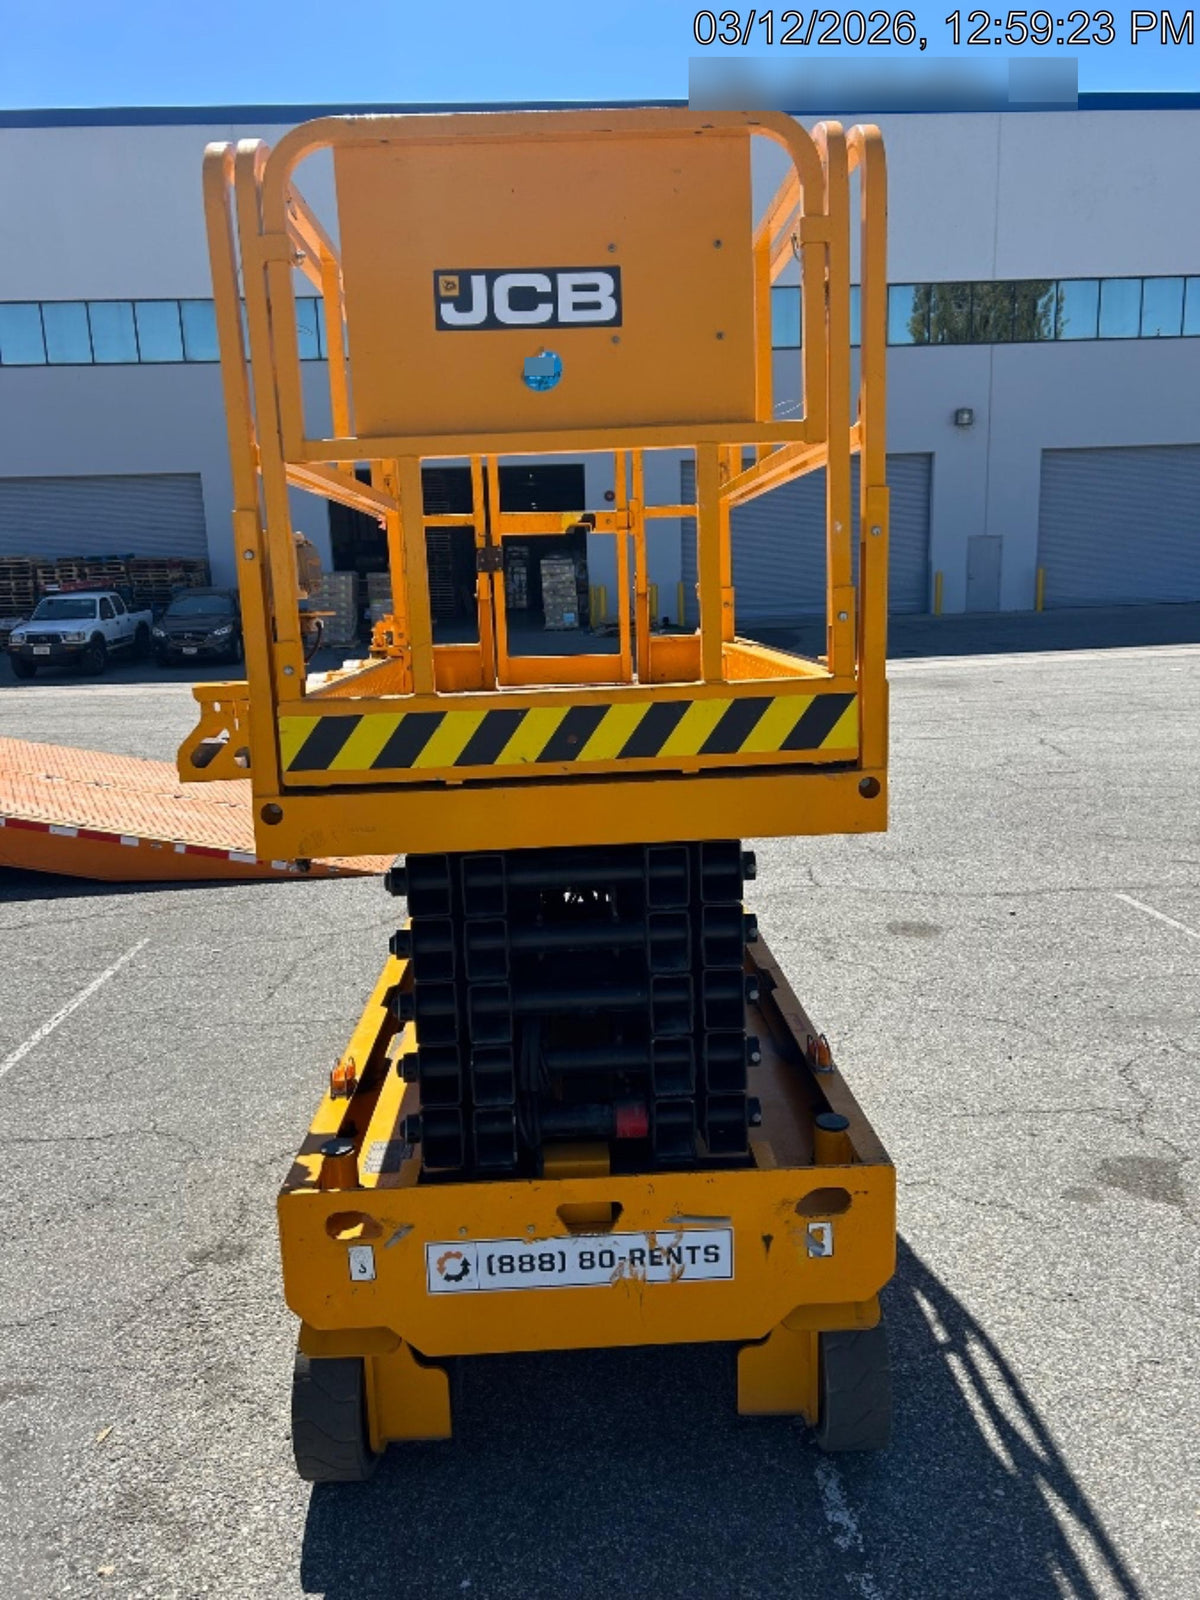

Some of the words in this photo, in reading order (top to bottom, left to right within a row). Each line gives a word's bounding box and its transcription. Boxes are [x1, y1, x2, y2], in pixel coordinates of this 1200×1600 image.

[440, 271, 618, 326] JCB
[486, 1251, 567, 1276] (888)
[578, 1244, 721, 1270] 80-RENTS
